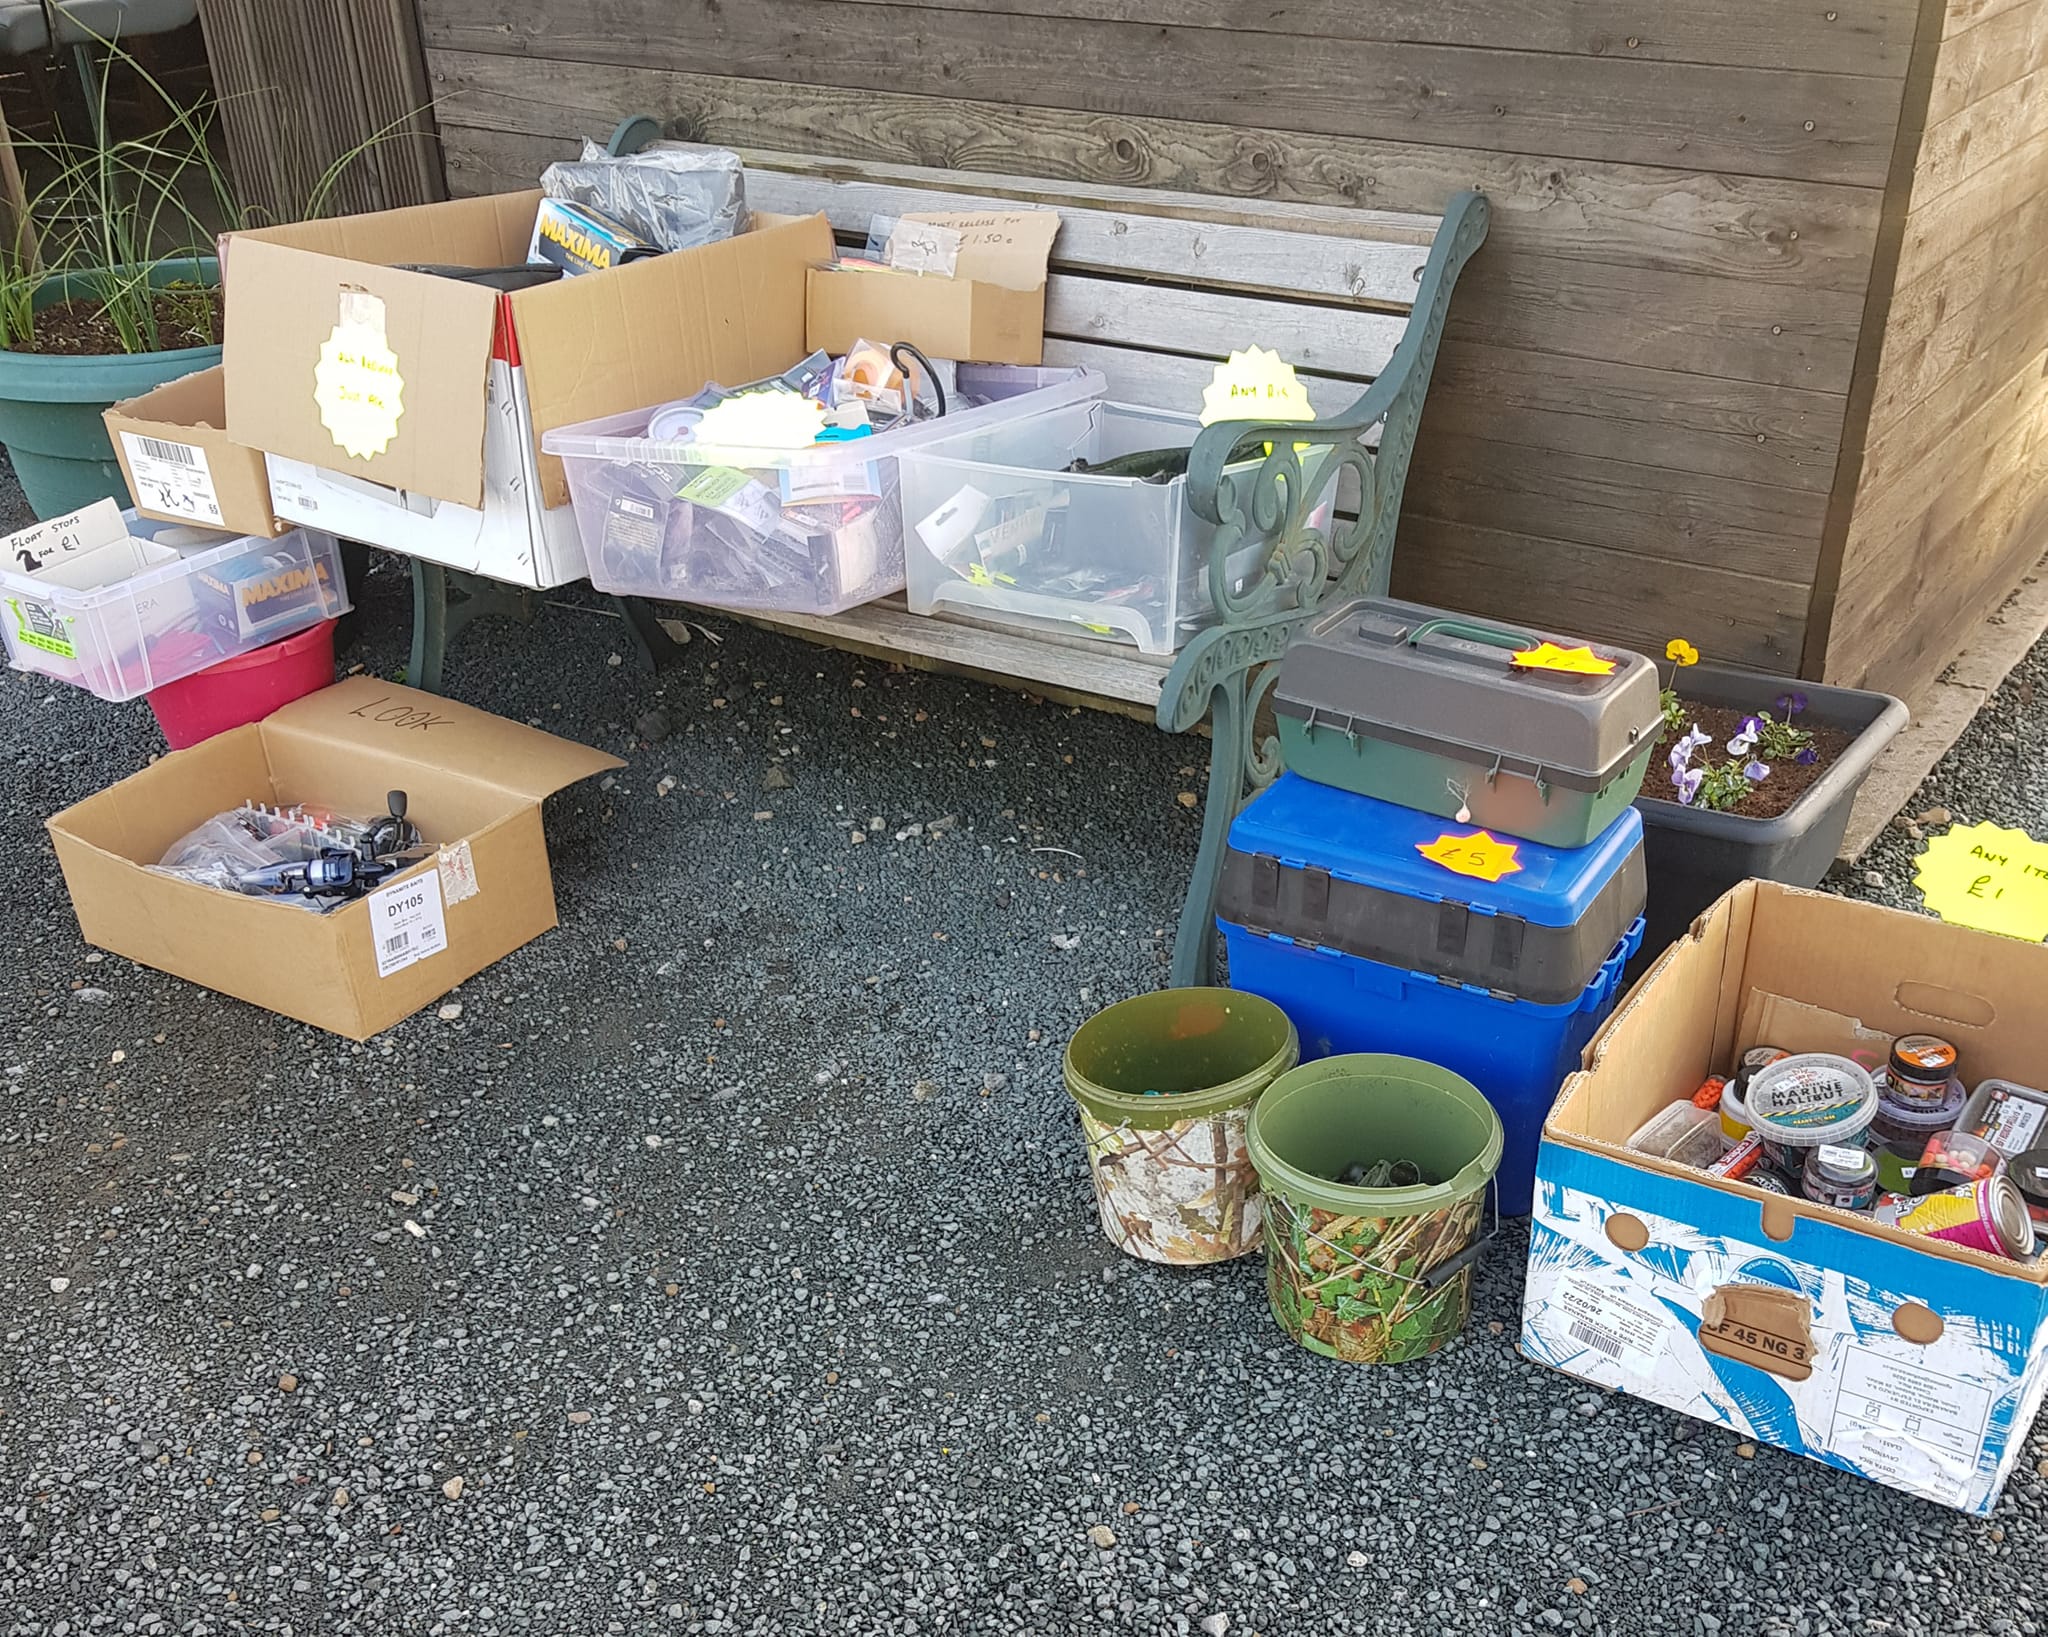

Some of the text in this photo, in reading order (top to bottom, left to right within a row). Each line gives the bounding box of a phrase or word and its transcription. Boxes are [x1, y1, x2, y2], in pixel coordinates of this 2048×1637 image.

[540, 213, 610, 270] MAXIMA
[10, 515, 80, 551] FLOAT STOPS
[16, 533, 80, 573] 2 FOR £1
[241, 562, 329, 607] MAXIMA
[348, 697, 455, 731] LOOK
[1970, 845, 2008, 866] ANY
[1967, 876, 2003, 899] £1
[388, 894, 424, 917] DY105
[1771, 1081, 1843, 1100] MARINE
[1772, 1090, 1844, 1107] HALIBUT
[1562, 1291, 1603, 1316] 26/02/22
[1734, 1328, 1757, 1345] 45
[1762, 1337, 1788, 1355] NG
[1883, 1439, 1903, 1451] CLASS
[1858, 1455, 1896, 1474] COSTA RICA
